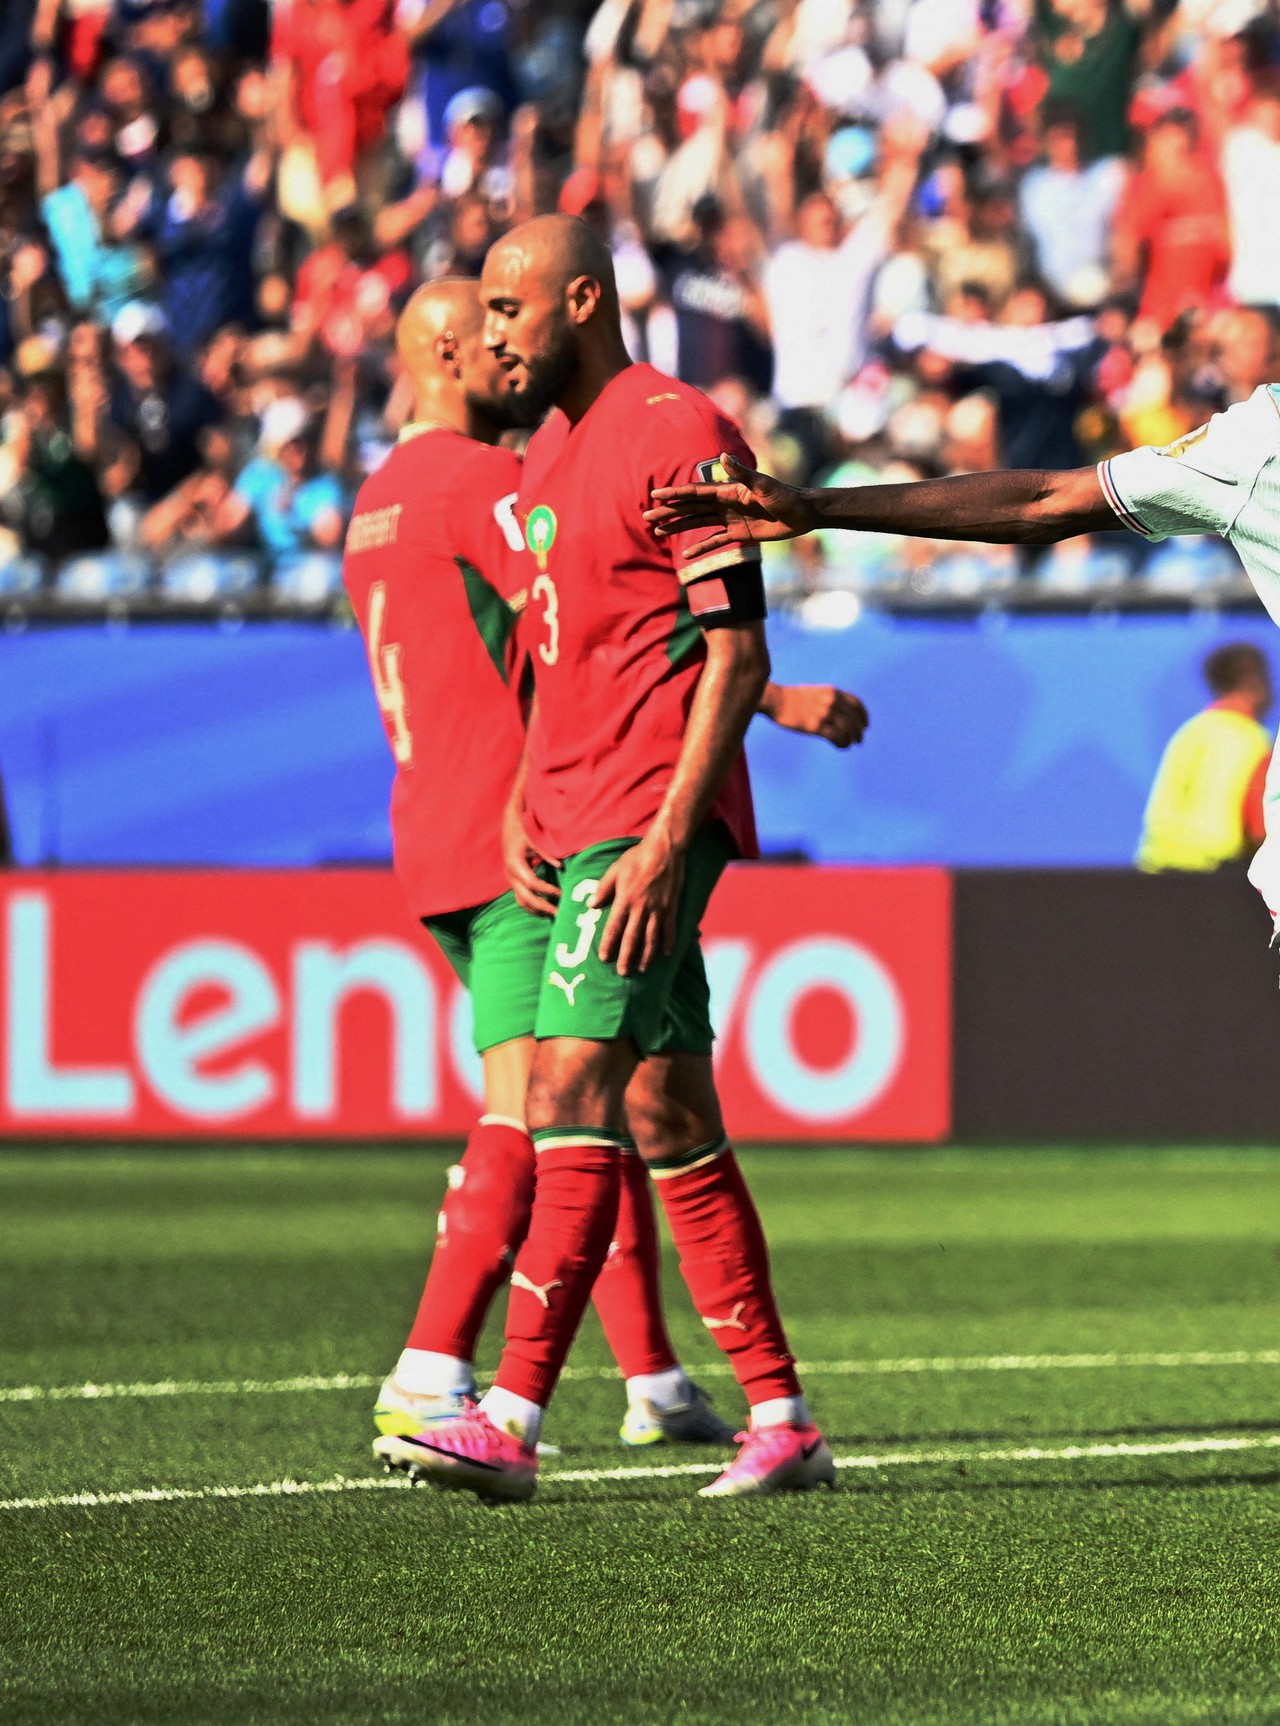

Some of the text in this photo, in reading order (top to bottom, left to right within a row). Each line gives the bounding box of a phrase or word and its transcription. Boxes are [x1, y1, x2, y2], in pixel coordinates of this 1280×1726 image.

[368, 580, 414, 769] 4
[532, 573, 559, 666] 3
[555, 879, 602, 968] 3
[6, 889, 905, 1122] Leno
